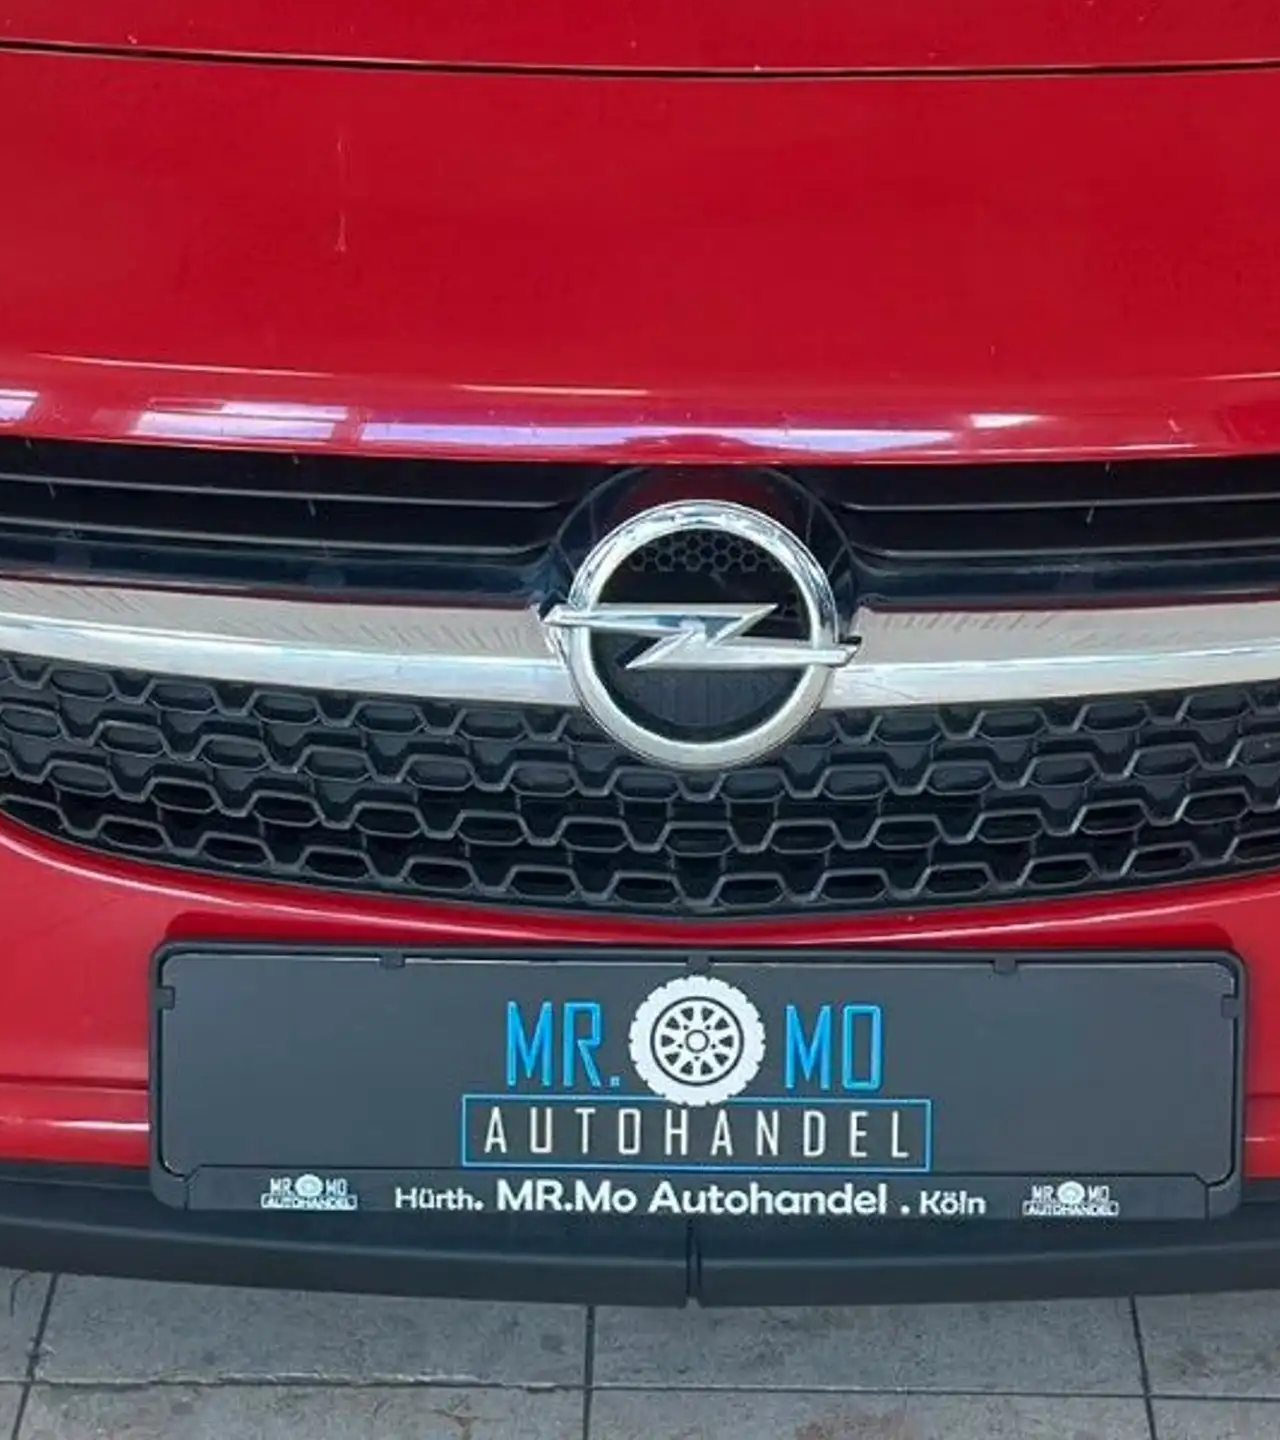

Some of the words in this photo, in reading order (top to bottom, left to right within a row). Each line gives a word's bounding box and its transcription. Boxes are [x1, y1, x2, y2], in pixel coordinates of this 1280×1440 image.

[506, 1000, 621, 1088] MR.
[784, 1004, 883, 1091] MO
[483, 1105, 910, 1159] AUTOHANDEL
[395, 1186, 485, 1211] Hürth.
[496, 1178, 638, 1213] MR.Mo
[647, 1180, 888, 1215] Autohandel
[920, 1189, 987, 1215] Köln
